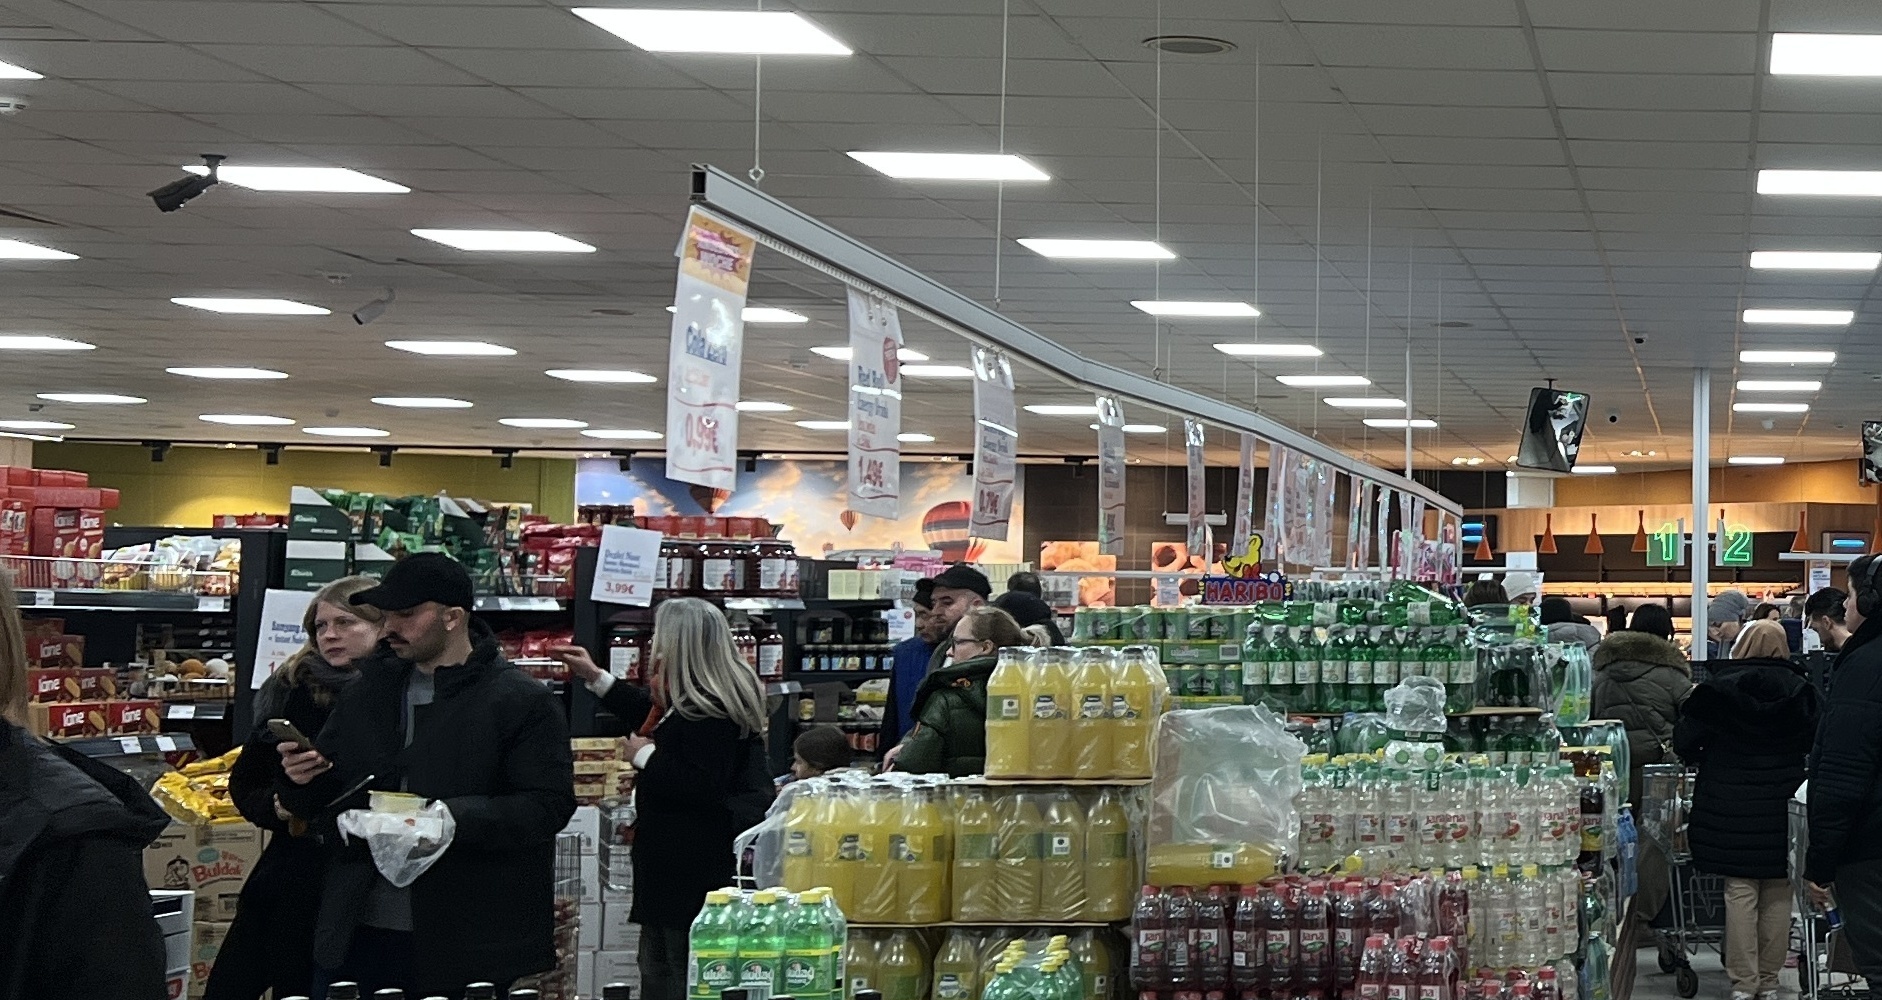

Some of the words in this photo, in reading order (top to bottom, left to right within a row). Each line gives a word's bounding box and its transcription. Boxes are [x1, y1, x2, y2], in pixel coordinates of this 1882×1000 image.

[1655, 523, 1673, 562] 1
[1724, 525, 1751, 562] 2
[604, 581, 635, 594] 3,99€
[1205, 581, 1283, 602] HARIBO
